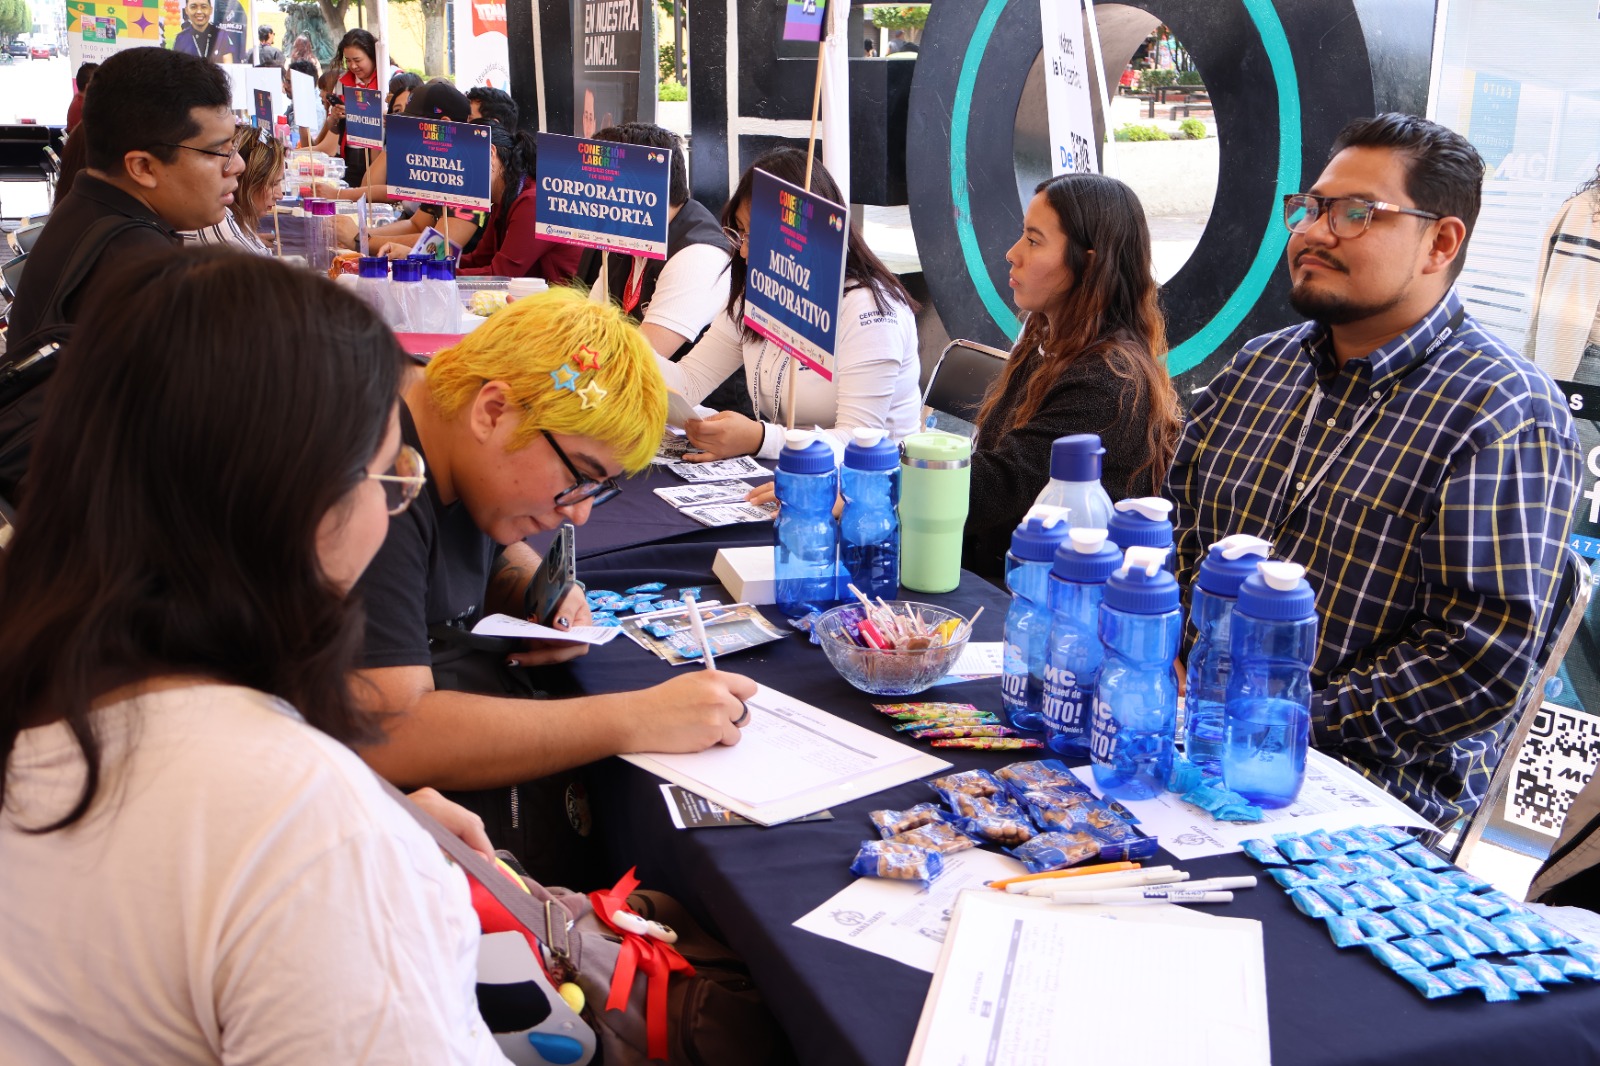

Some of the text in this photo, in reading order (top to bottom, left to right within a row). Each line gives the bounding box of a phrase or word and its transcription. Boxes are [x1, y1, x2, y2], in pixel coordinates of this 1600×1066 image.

[585, 0, 640, 33] EN NUESTRA
[584, 34, 618, 66] CANCHA.
[405, 153, 465, 172] GENERAL
[582, 153, 620, 169] LABORAL
[409, 168, 464, 187] MOTORS
[542, 176, 658, 208] CORPORATIVO
[547, 196, 654, 227] TRANSPORTA
[768, 249, 811, 291] MUÑOZ
[750, 268, 831, 333] CORPORATIVO
[1071, 689, 1082, 700] de
